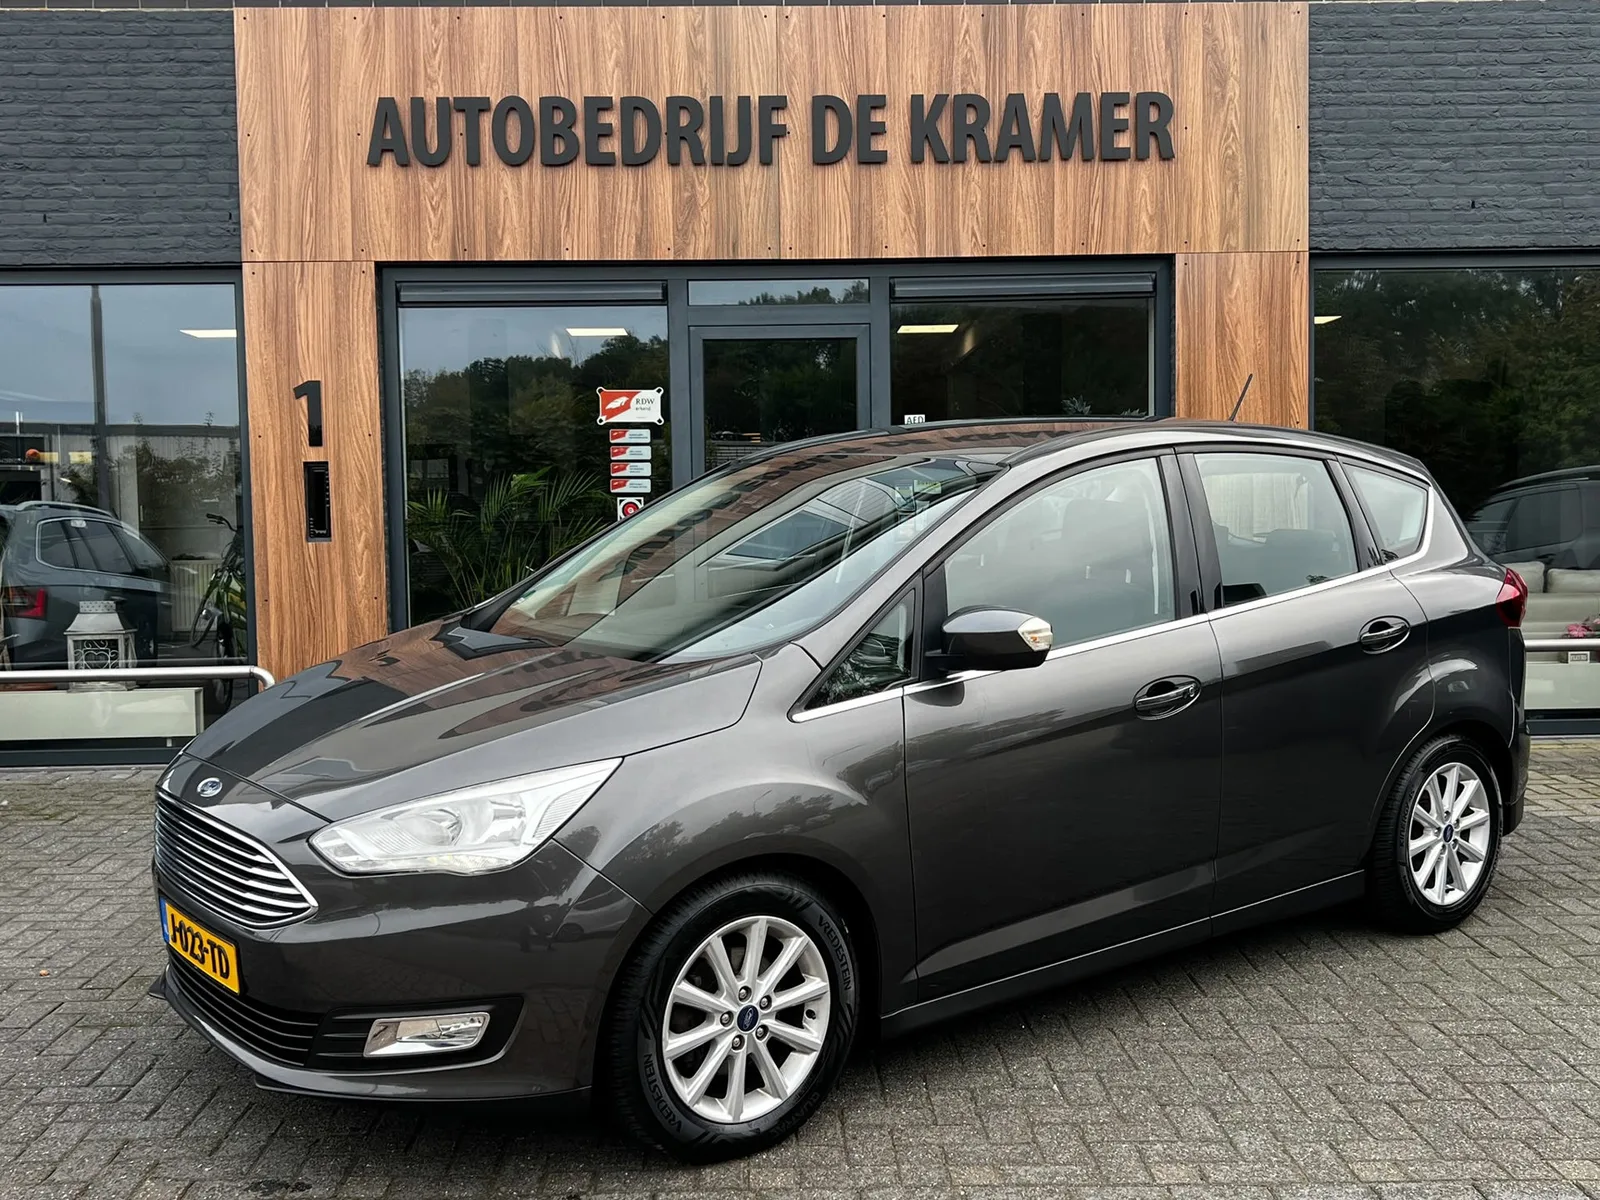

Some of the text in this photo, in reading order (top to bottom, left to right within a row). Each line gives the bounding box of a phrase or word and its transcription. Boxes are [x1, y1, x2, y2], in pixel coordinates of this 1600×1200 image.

[367, 92, 1175, 167] AUTOBEDRIJF DE KRAMER
[293, 380, 323, 447] 1
[906, 416, 923, 425] AED
[170, 913, 230, 979] J-023-TD
[818, 914, 852, 991] VREDESTEIN
[643, 1053, 682, 1133] VREDESTEIN
